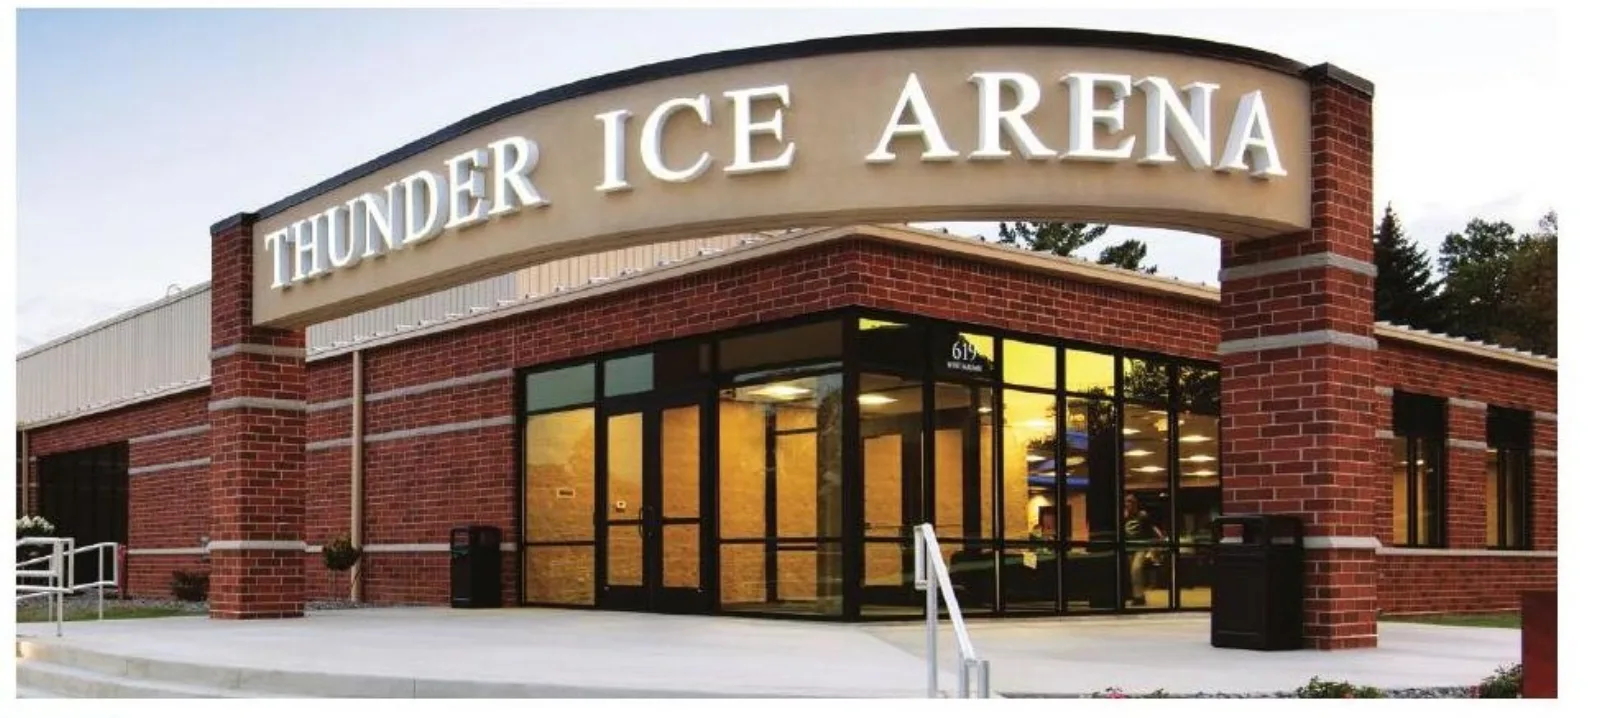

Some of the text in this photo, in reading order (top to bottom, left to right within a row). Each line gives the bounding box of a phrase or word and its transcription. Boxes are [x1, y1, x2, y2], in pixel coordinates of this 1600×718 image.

[264, 72, 1288, 289] THUNDER ICE ARENA
[952, 341, 977, 361] 619
